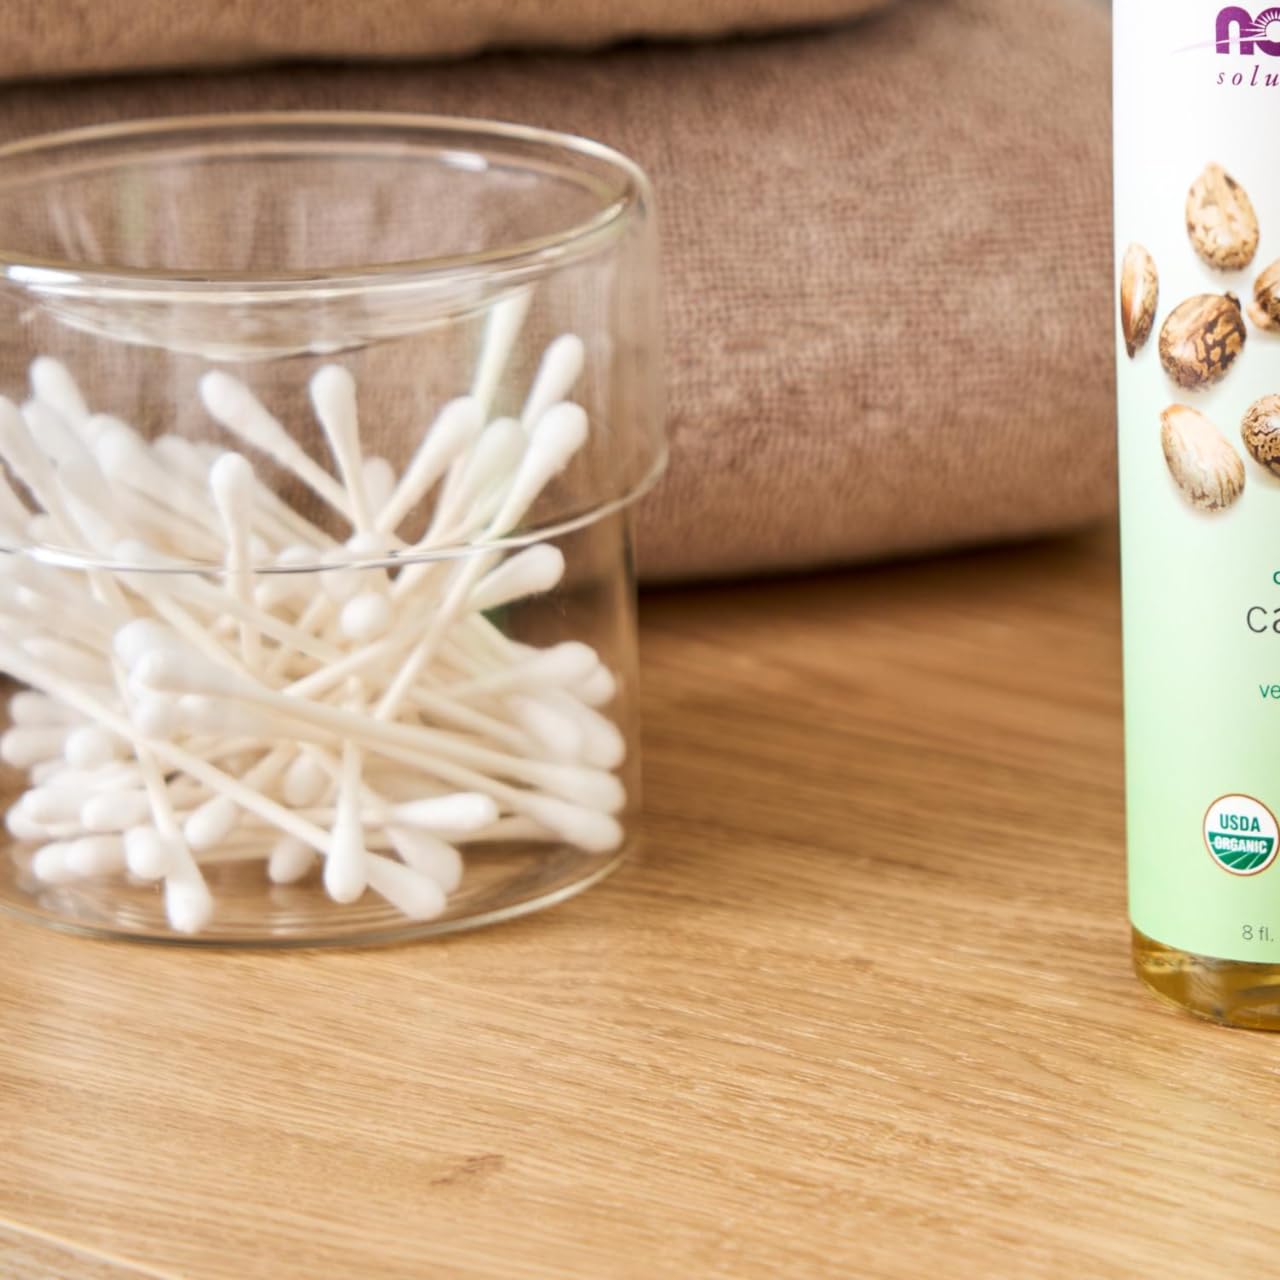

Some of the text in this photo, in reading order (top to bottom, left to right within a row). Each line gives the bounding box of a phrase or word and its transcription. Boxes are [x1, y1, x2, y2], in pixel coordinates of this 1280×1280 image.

[1219, 813, 1261, 833] USDA
[1213, 835, 1268, 854] ORGANIC
[1241, 924, 1254, 941] 8
[1258, 926, 1274, 942] fl.
